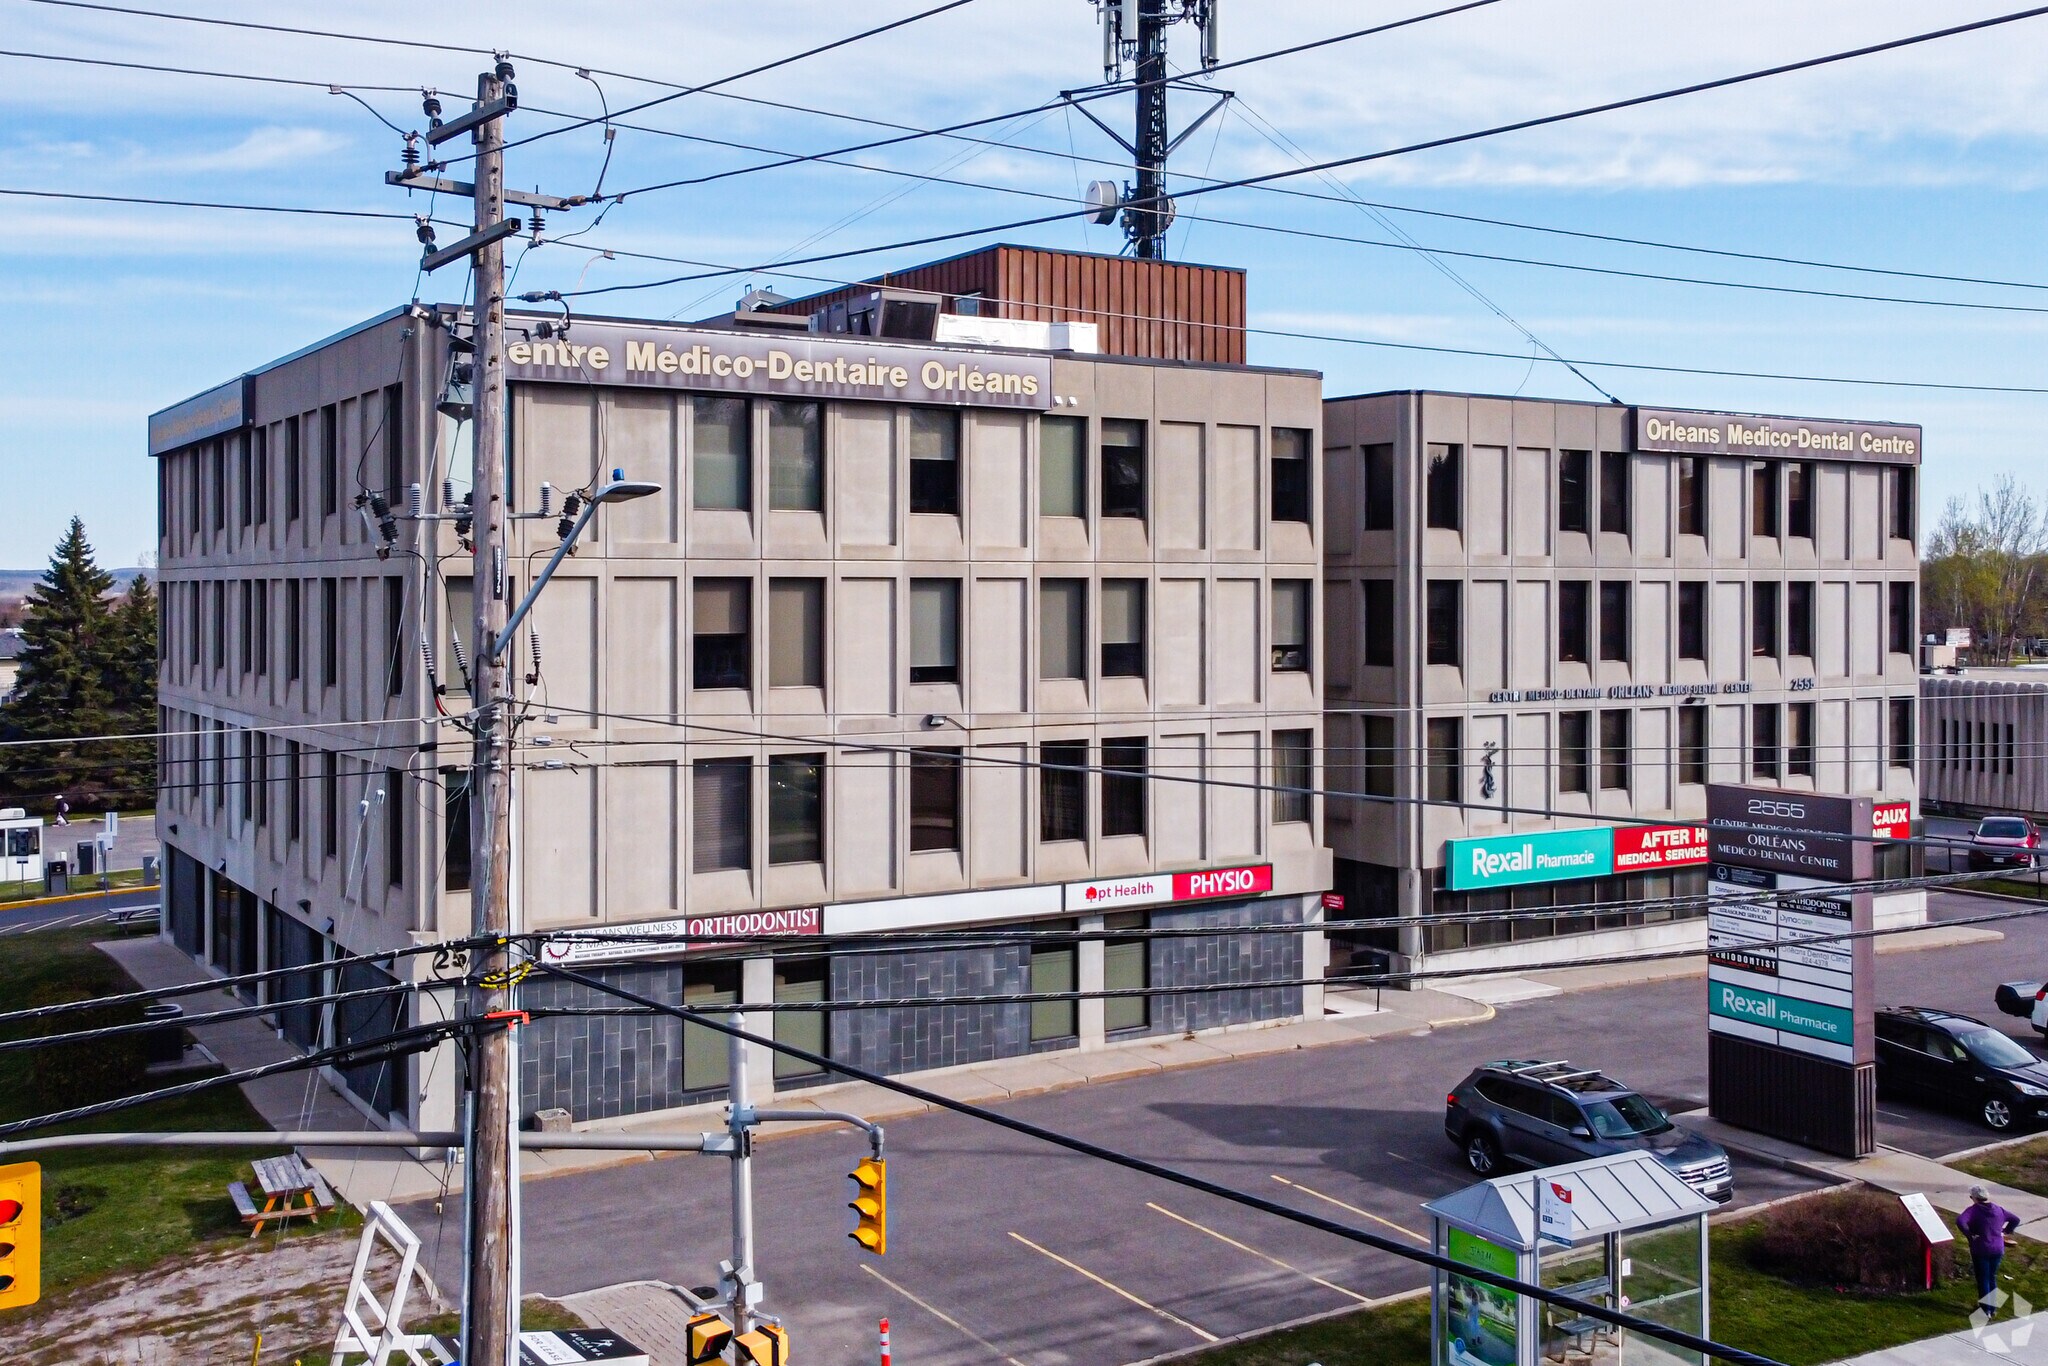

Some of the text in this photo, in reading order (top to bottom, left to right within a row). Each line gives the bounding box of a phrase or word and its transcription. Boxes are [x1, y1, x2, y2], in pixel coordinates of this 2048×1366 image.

[505, 338, 1039, 395] entre Médico-Dentaire Orléans
[1646, 417, 1915, 455] Orleans Medico-Dental Centre
[1490, 689, 1525, 702] CENTR
[1527, 687, 1603, 701] MEDICO-DENTAIR
[1659, 682, 1720, 697] MEDICO-DENTA
[1789, 677, 1816, 691] 2555
[1747, 799, 1805, 819] 2555
[1713, 818, 1749, 828] CENTRE
[1641, 827, 1708, 849] AFTER H
[1747, 834, 1806, 852] ORLÉANS
[1472, 843, 1595, 878] Rexall Pharmacie
[1617, 850, 1662, 866] MEDICAL
[1800, 855, 1839, 869] CENTRE
[1114, 881, 1154, 898] Health
[1190, 869, 1254, 895] PHYSIO
[625, 921, 679, 935] WELLNESS
[689, 907, 820, 936] ORTHODONTIST
[1709, 952, 1776, 969] ERIODONTIST
[1807, 949, 1829, 960] Dental
[1722, 987, 1838, 1033] Rexall Pharmacie
[542, 1347, 564, 1362] LEASE
